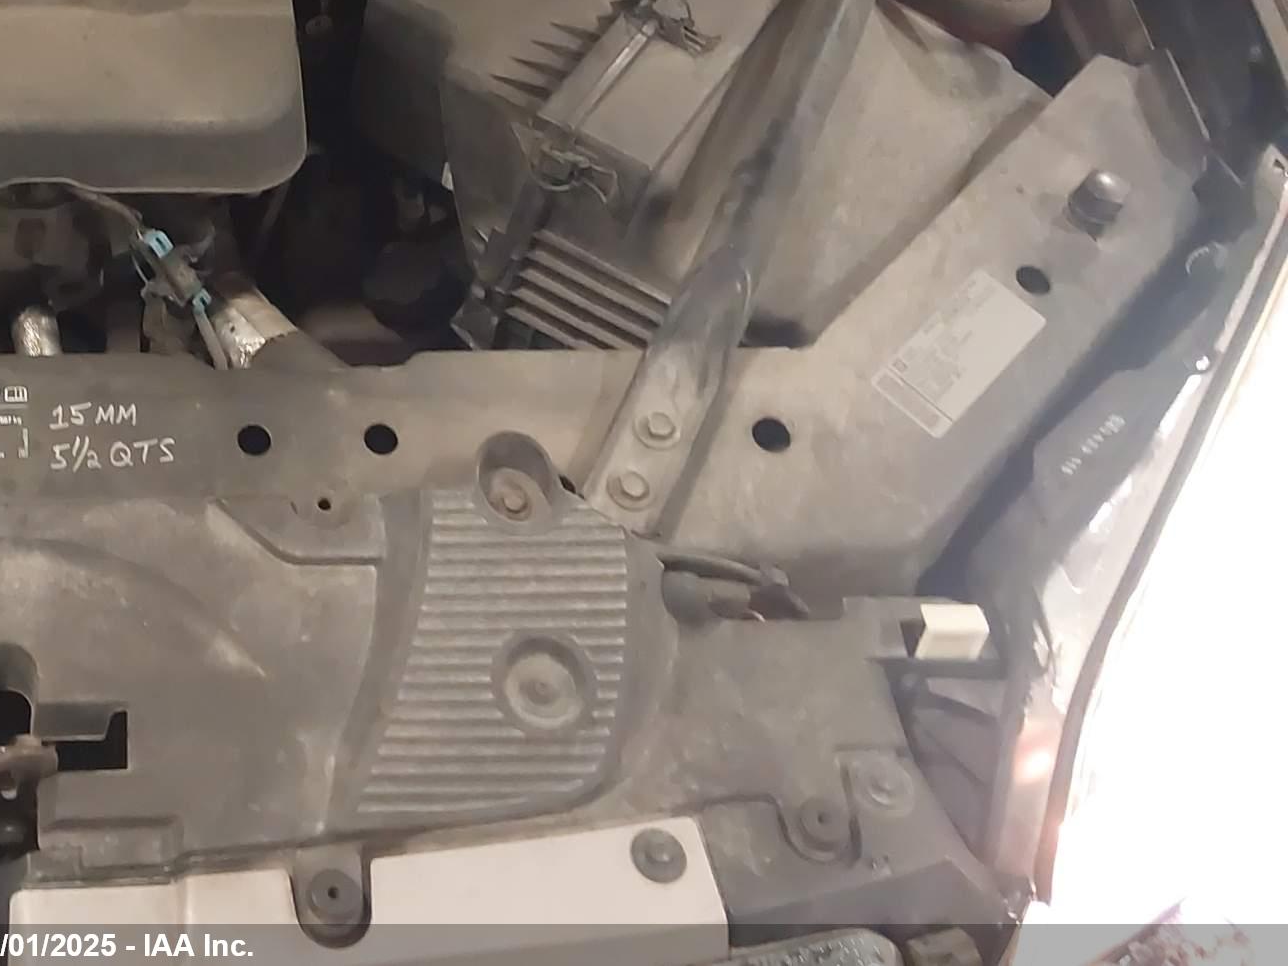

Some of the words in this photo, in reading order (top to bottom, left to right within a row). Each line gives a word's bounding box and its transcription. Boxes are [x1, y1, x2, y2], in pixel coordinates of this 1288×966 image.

[49, 401, 92, 430] 15
[95, 403, 137, 426] MM
[110, 437, 176, 467] QTS
